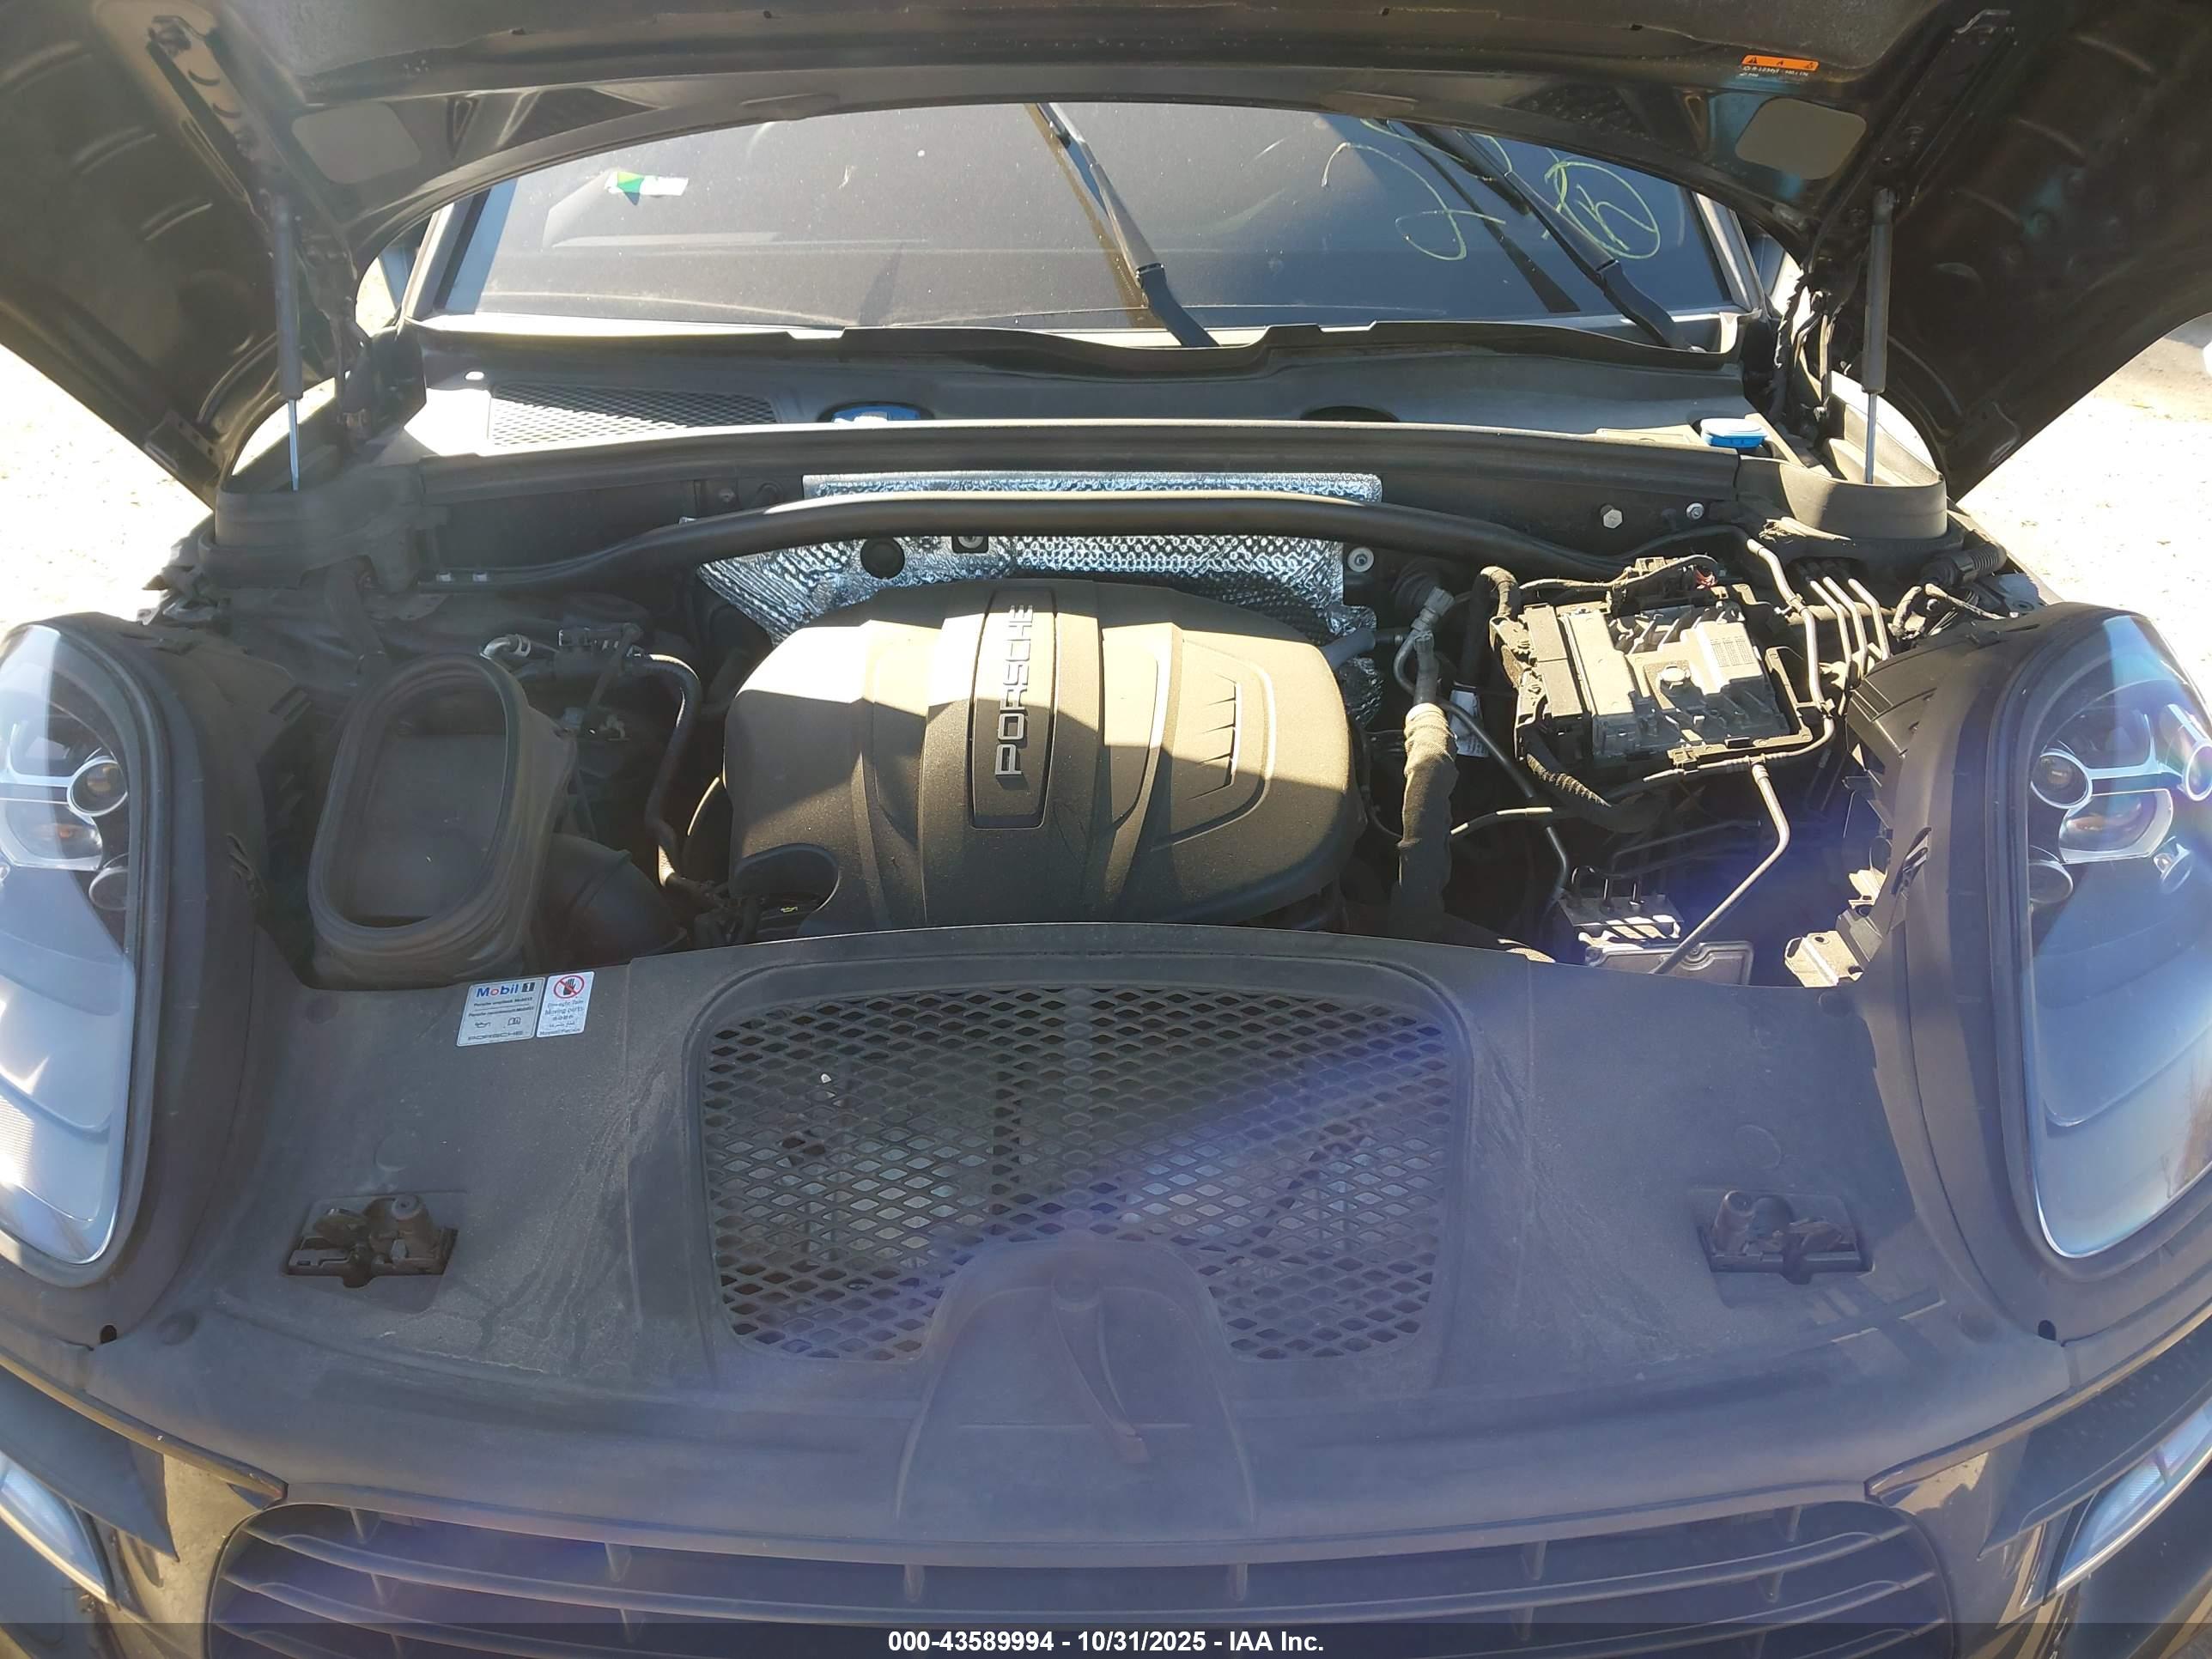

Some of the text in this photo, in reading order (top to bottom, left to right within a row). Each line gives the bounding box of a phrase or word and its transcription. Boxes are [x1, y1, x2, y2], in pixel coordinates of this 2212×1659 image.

[995, 605, 1034, 775] PORSCHE
[476, 983, 519, 998] Mobil
[468, 1030, 523, 1042] PORSCHE
